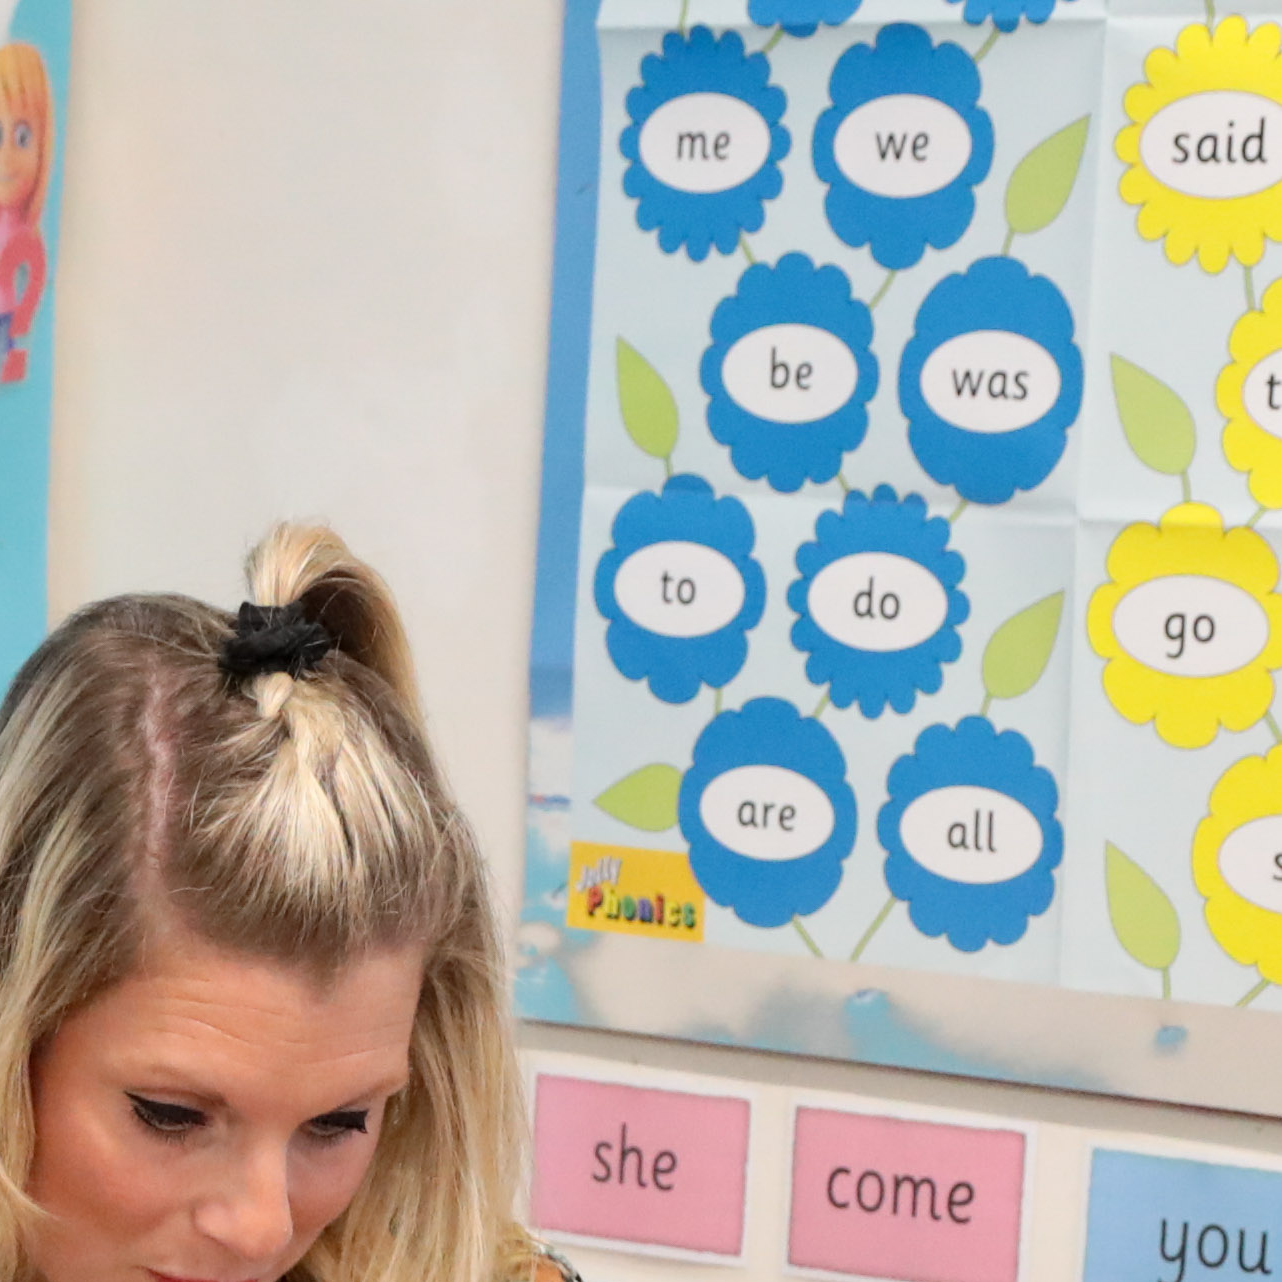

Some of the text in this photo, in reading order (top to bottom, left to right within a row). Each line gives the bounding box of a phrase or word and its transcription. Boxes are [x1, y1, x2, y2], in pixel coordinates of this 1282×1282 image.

[676, 128, 731, 161] me
[874, 130, 931, 163] we
[1172, 116, 1269, 166] said
[770, 347, 814, 393] be
[951, 366, 1030, 402] was
[661, 569, 697, 606] to
[853, 576, 901, 622] do
[1163, 609, 1217, 659] go
[736, 797, 797, 834] are
[947, 809, 998, 855] all
[586, 884, 697, 930] Phonics
[591, 1122, 679, 1193] she
[826, 1164, 977, 1225] come
